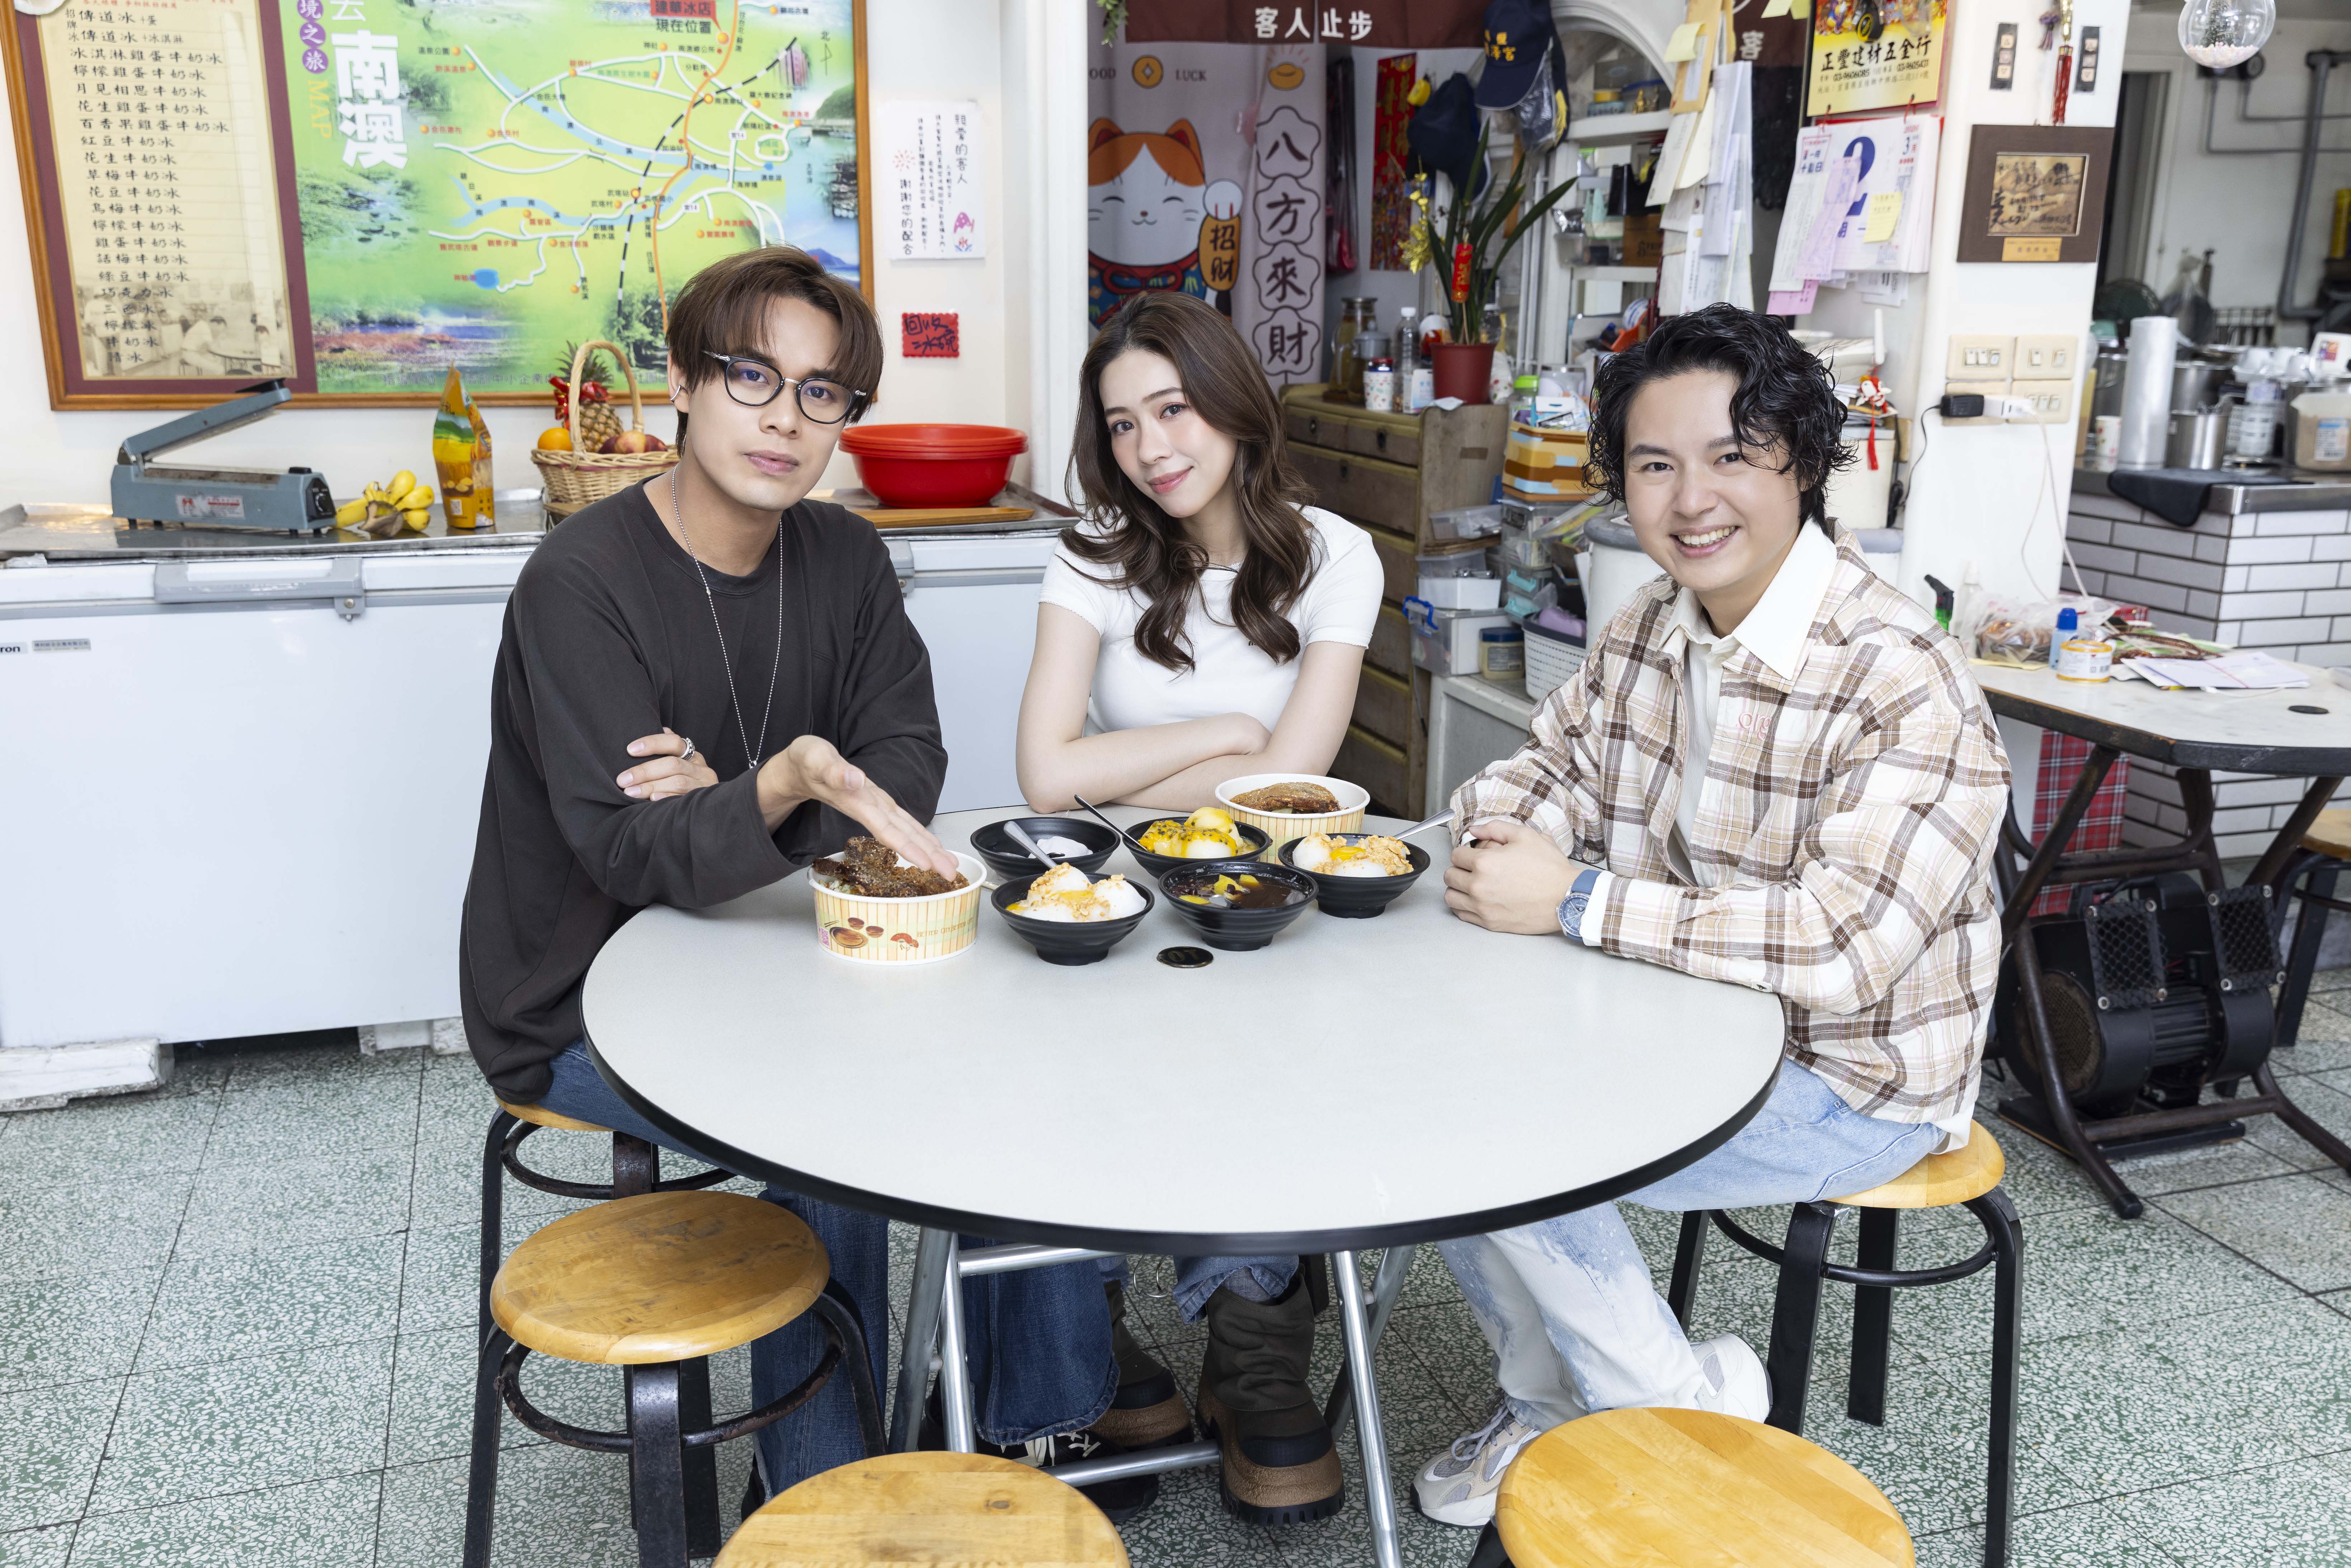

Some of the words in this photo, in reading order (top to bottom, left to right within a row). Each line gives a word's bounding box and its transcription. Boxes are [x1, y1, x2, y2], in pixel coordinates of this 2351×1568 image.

[655, 0, 711, 16] 建華冰店
[656, 19, 711, 34] 現在位置
[1255, 7, 1373, 41] 客人止步
[821, 31, 830, 41] 北
[1176, 69, 1206, 81] LUCK
[76, 83, 208, 99] 月見相思牛奶冰
[330, 29, 409, 170] 南澳
[77, 100, 209, 116] 花生雞蛋牛奶冰
[307, 80, 333, 138] MAP
[79, 118, 230, 133] 百香果雞蛋牛奶冰
[81, 136, 176, 149] 紅豆牛奶冰
[1902, 137, 1910, 155] 3
[84, 151, 178, 166] 花生牛奶冰
[89, 186, 182, 199] 花豆牛奶冰
[92, 203, 183, 215] 烏梅牛奶冰
[93, 220, 185, 233] 檸檬牛奶冰
[95, 236, 187, 249] 雞蛋牛奶冰
[1265, 131, 1310, 365] 八方來財
[96, 253, 189, 265] 話梅牛奶冰
[1210, 224, 1236, 283] 招財
[99, 270, 191, 283] 綠豆牛奶冰
[102, 287, 174, 299] 巧克力冰
[905, 316, 949, 335] 回收
